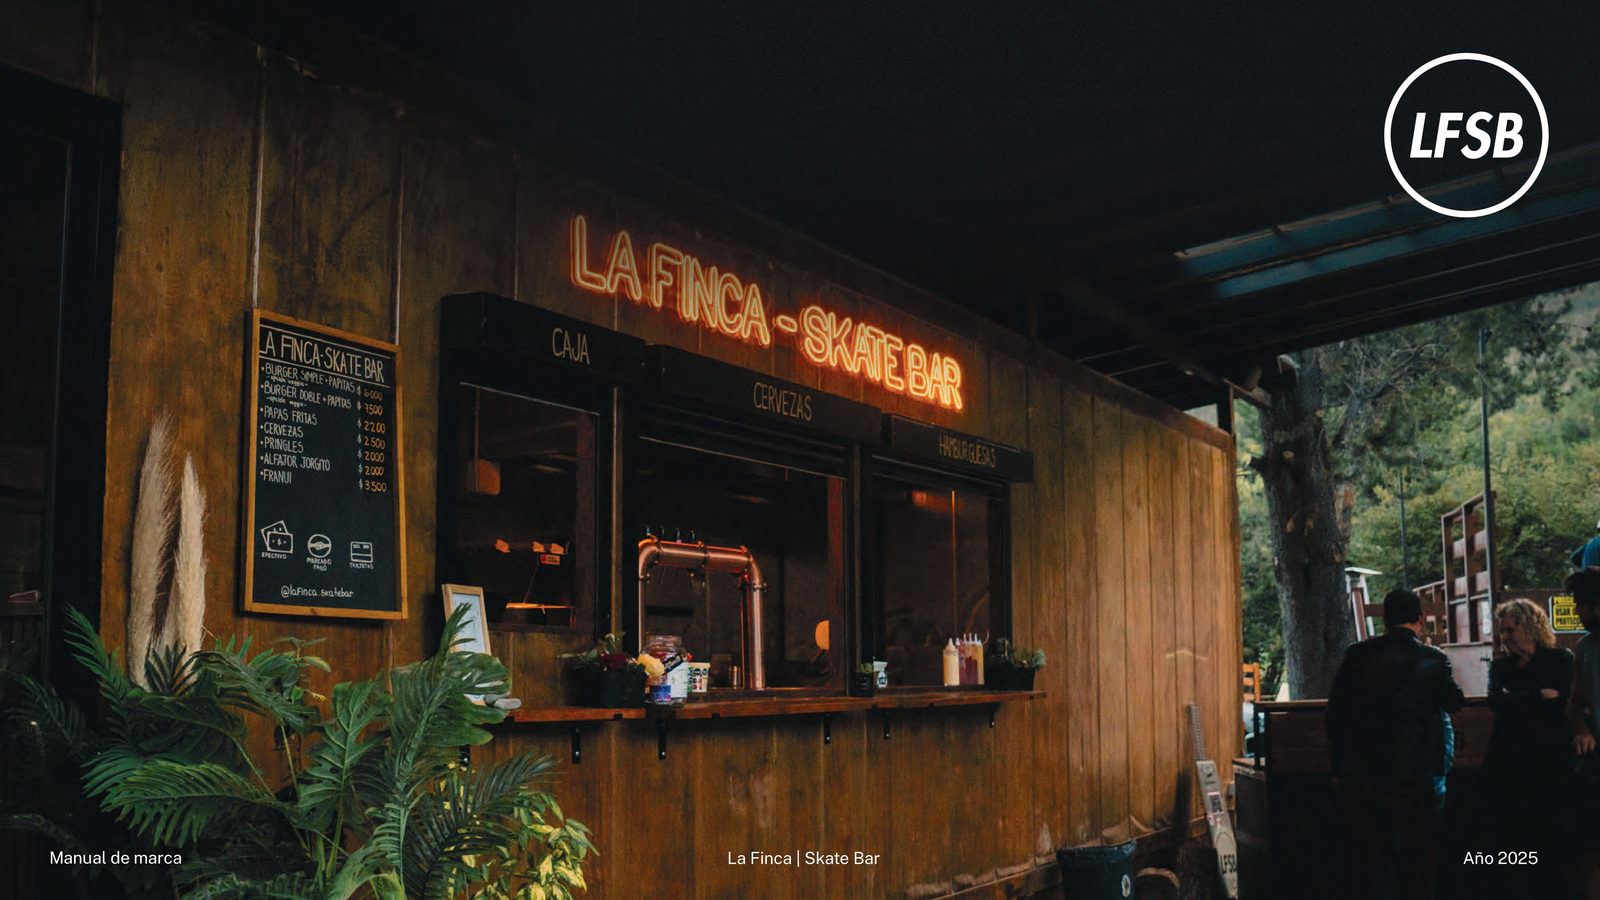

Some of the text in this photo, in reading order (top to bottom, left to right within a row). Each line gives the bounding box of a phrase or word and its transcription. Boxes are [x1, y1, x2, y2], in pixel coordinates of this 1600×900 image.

[571, 215, 642, 301] LA
[648, 243, 770, 346] FINCA
[801, 305, 904, 391] SKATE
[905, 343, 963, 410] BAR
[552, 327, 591, 365] CAJA
[265, 362, 298, 379] BURGER
[300, 370, 324, 385] SIMPLE
[328, 376, 355, 393] PAPITAS
[364, 357, 385, 383] BAR
[264, 381, 297, 398] BURGER
[300, 386, 321, 404] DOBLE
[327, 394, 352, 409] PAPITAS
[753, 381, 813, 422] CERVEZAS
[264, 405, 288, 421] PAPAS
[292, 410, 317, 426] FRITAS
[364, 421, 386, 434] 2200
[263, 422, 304, 438] CERVEZAS
[364, 436, 386, 450] 2500
[264, 437, 304, 453] PRINGLES
[364, 451, 385, 463] 2000
[263, 452, 298, 468] ALFAJOR
[300, 456, 331, 472] JORGITO
[364, 465, 385, 476] 2000
[263, 468, 292, 484] FRANUI
[364, 480, 387, 492] 3500
